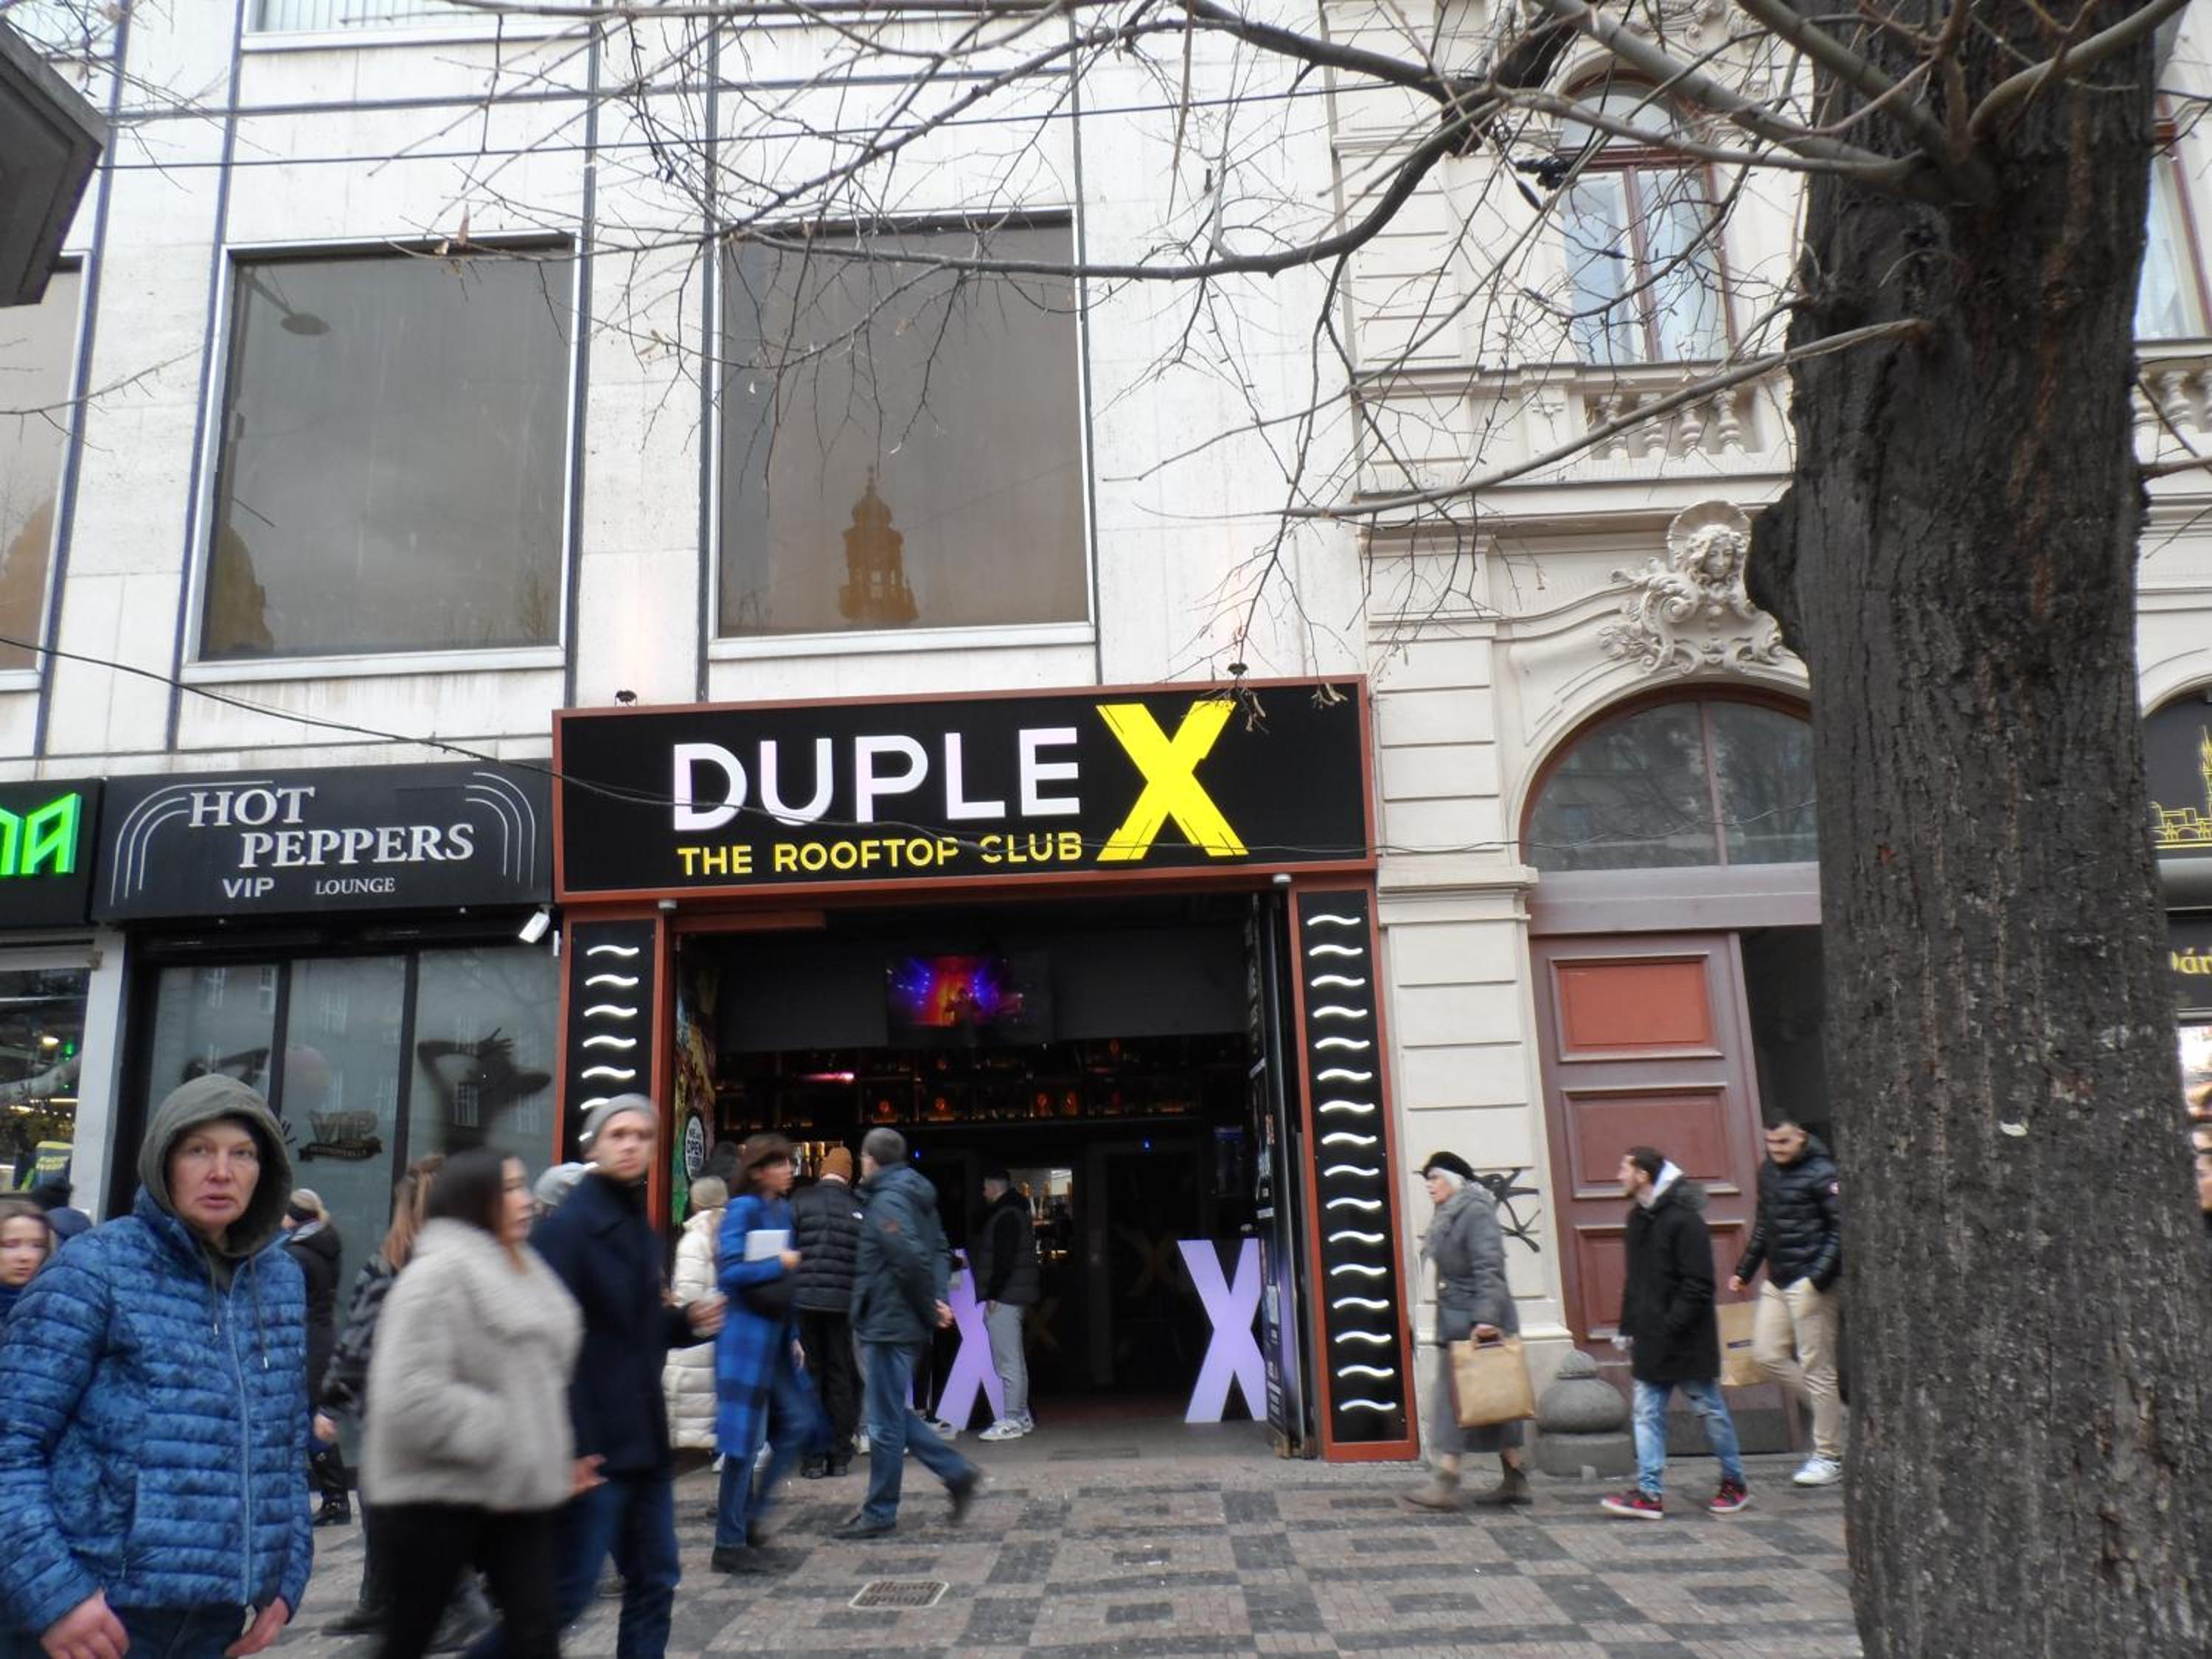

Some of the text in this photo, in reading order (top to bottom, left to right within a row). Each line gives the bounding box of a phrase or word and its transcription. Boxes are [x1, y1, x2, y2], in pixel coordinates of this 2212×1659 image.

[674, 700, 1249, 861] DUPLEX
[189, 787, 315, 827] HOT
[238, 824, 474, 868] PEPPERS
[676, 832, 1083, 876] THE ROOFTOP CLUB
[222, 877, 396, 899] VIP LOUNGE
